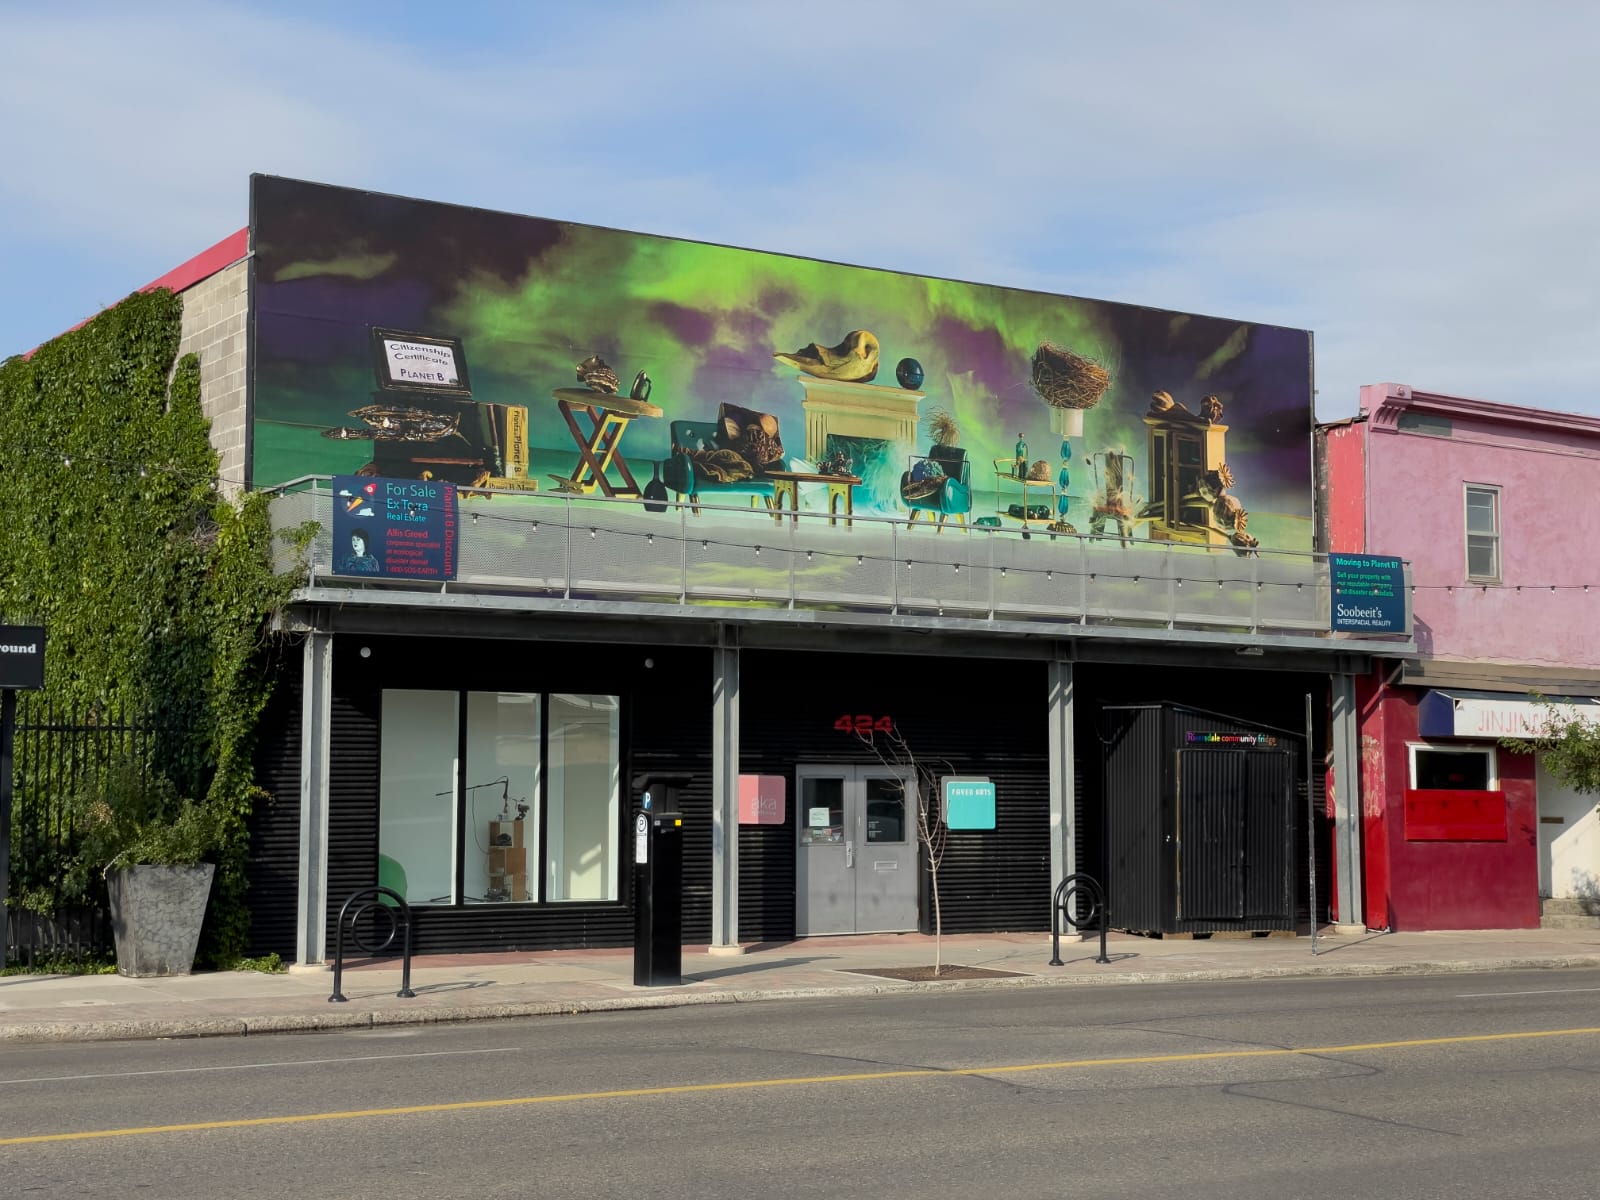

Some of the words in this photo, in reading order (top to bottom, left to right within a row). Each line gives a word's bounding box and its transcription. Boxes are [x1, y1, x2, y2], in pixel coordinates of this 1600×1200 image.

[390, 343, 451, 358] Citizenship
[394, 353, 449, 366] Certificate
[437, 372, 445, 381] B
[386, 483, 407, 496] For
[410, 485, 436, 498] Sale
[387, 498, 400, 509] Ex
[387, 512, 403, 521] Real
[444, 530, 454, 576] Discount
[1336, 557, 1362, 568] Moving
[1371, 560, 1391, 569] Planet
[1337, 603, 1382, 618] Soobeeit's
[0, 643, 37, 654] ound
[834, 714, 893, 734] 424
[1221, 733, 1257, 745] community
